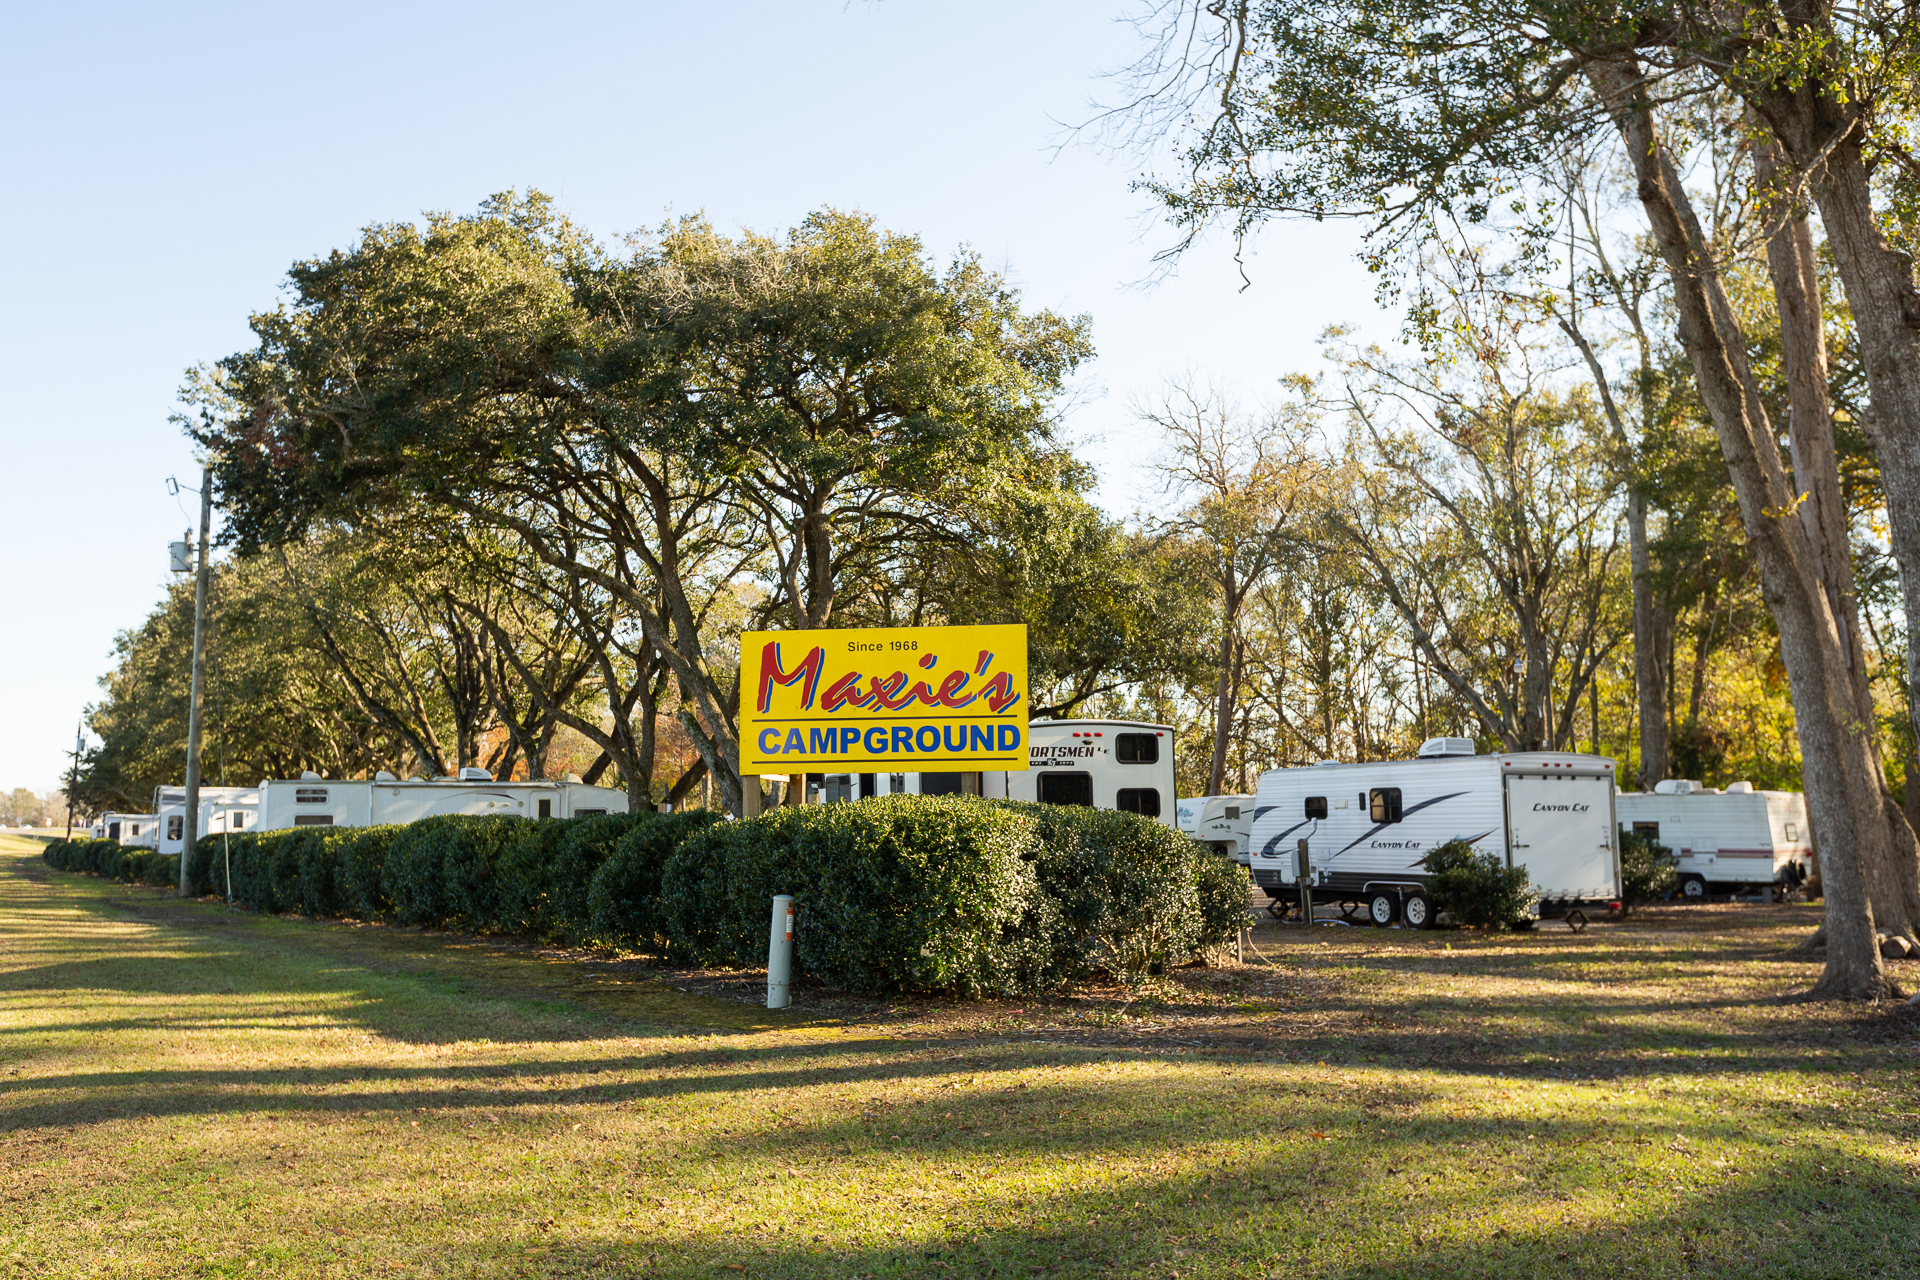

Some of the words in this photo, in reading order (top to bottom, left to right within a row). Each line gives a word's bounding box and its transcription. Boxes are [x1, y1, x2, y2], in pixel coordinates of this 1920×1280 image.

[847, 641, 883, 652] Since
[889, 640, 918, 651] 1968
[756, 640, 1021, 714] Maxie's
[757, 724, 1021, 755] CAMPGROUND
[1029, 746, 1095, 758] ORTSMEN
[1532, 802, 1571, 812] CANYON
[1572, 802, 1590, 812] CAT
[1370, 840, 1404, 849] CANYON
[1404, 840, 1421, 849] CAT
